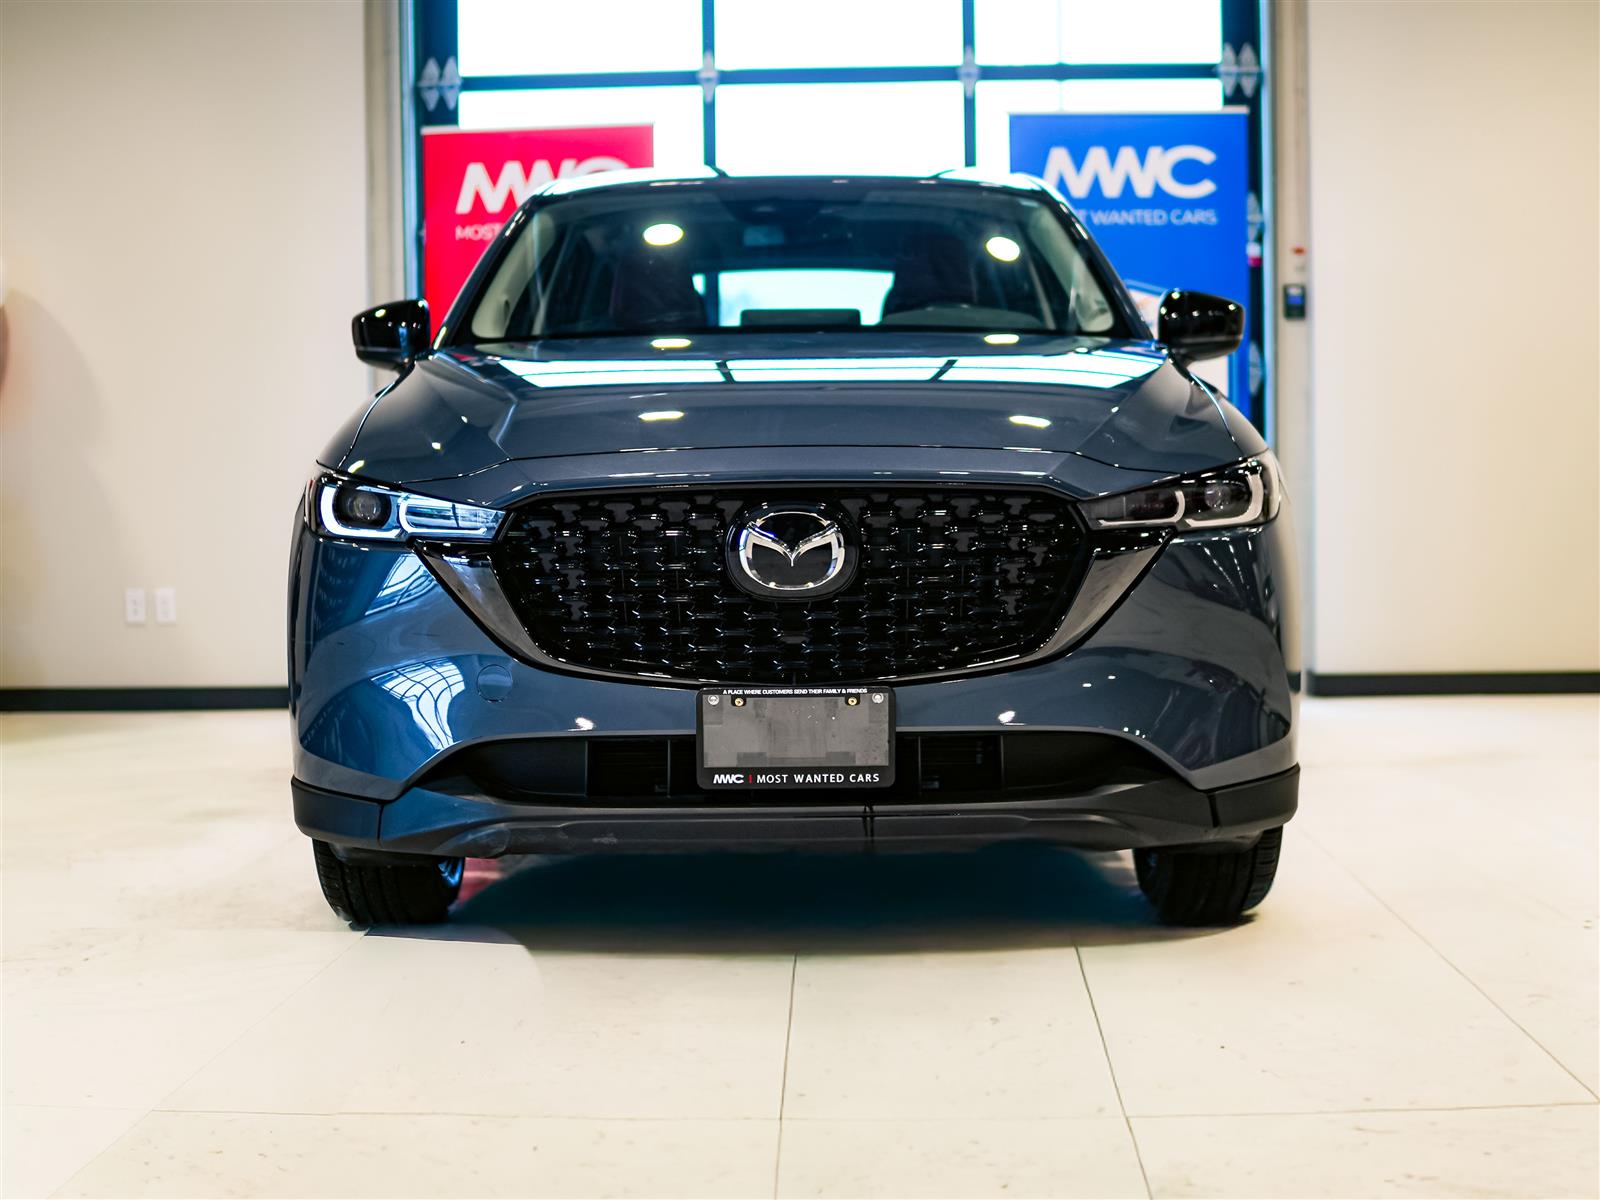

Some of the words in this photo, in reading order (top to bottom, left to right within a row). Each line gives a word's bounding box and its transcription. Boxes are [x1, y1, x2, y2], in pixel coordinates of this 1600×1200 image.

[1042, 144, 1217, 199] MWC
[1091, 208, 1168, 226] WANTED
[1170, 208, 1217, 225] CARS
[713, 774, 744, 783] MWC
[756, 774, 789, 783] MOST
[794, 773, 844, 783] WANTED
[849, 773, 880, 783] CARS
